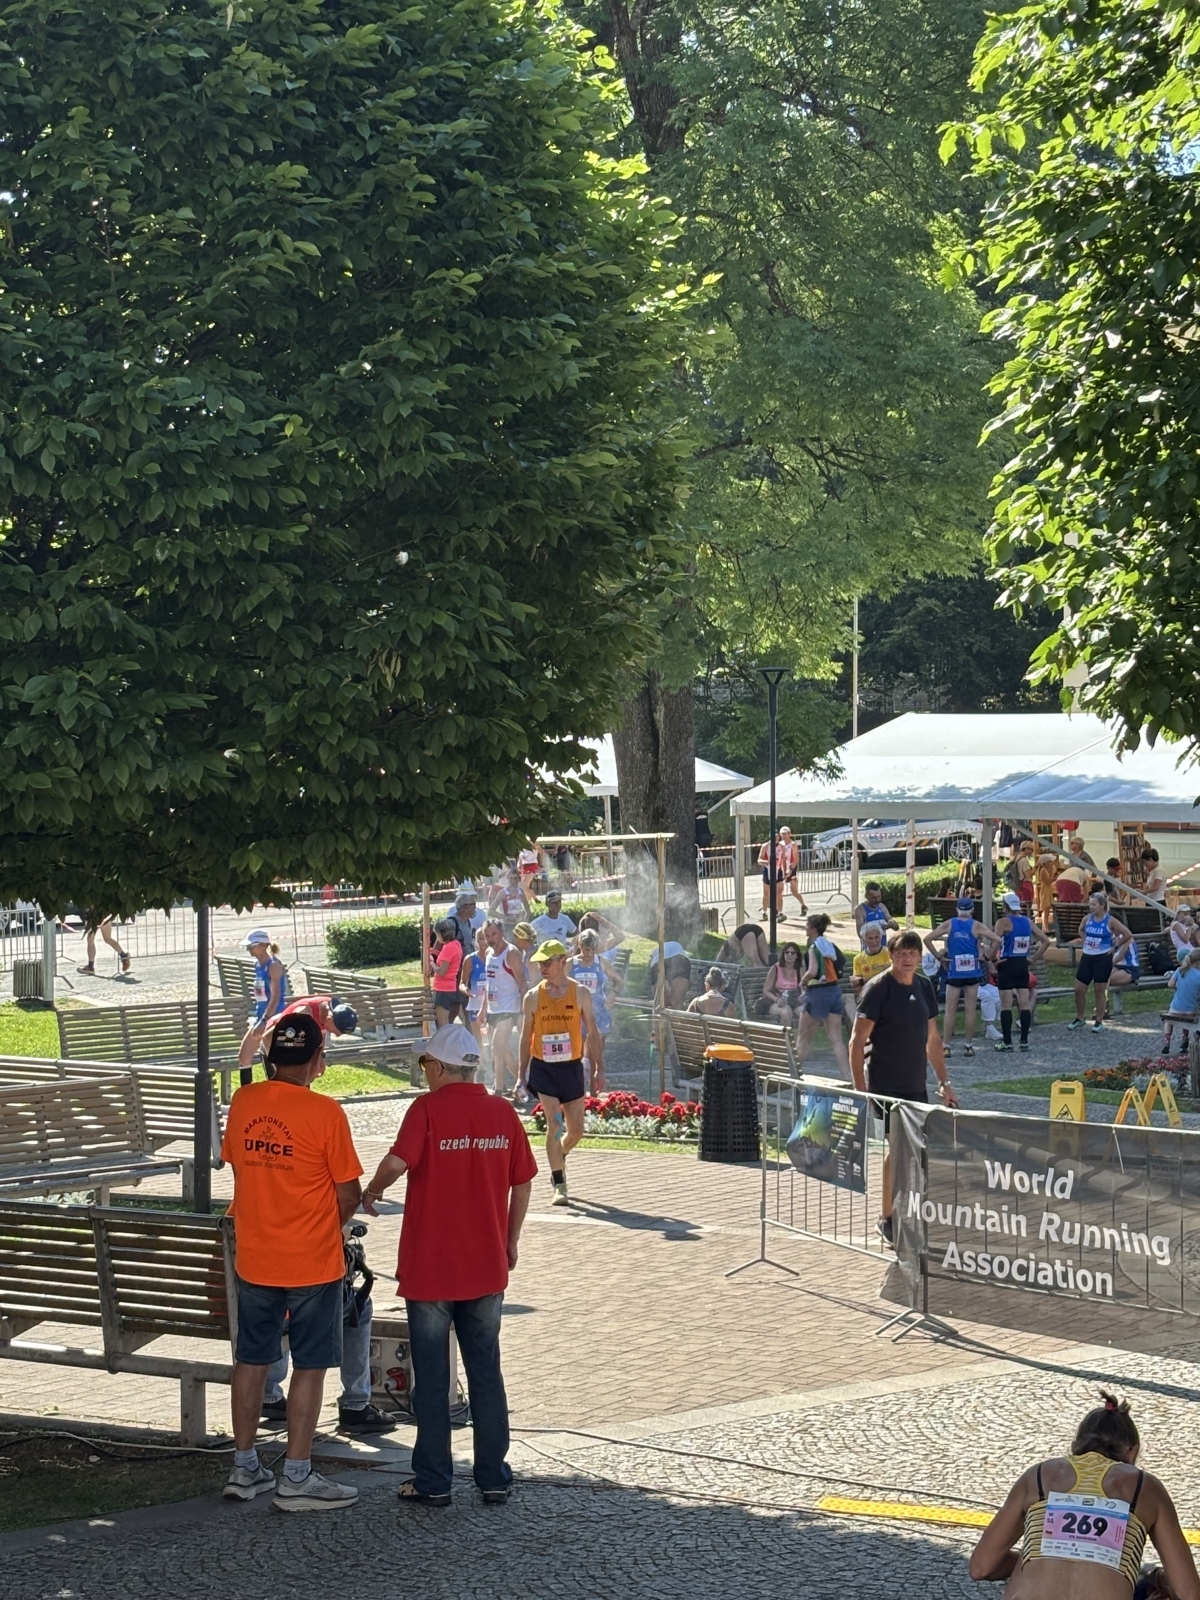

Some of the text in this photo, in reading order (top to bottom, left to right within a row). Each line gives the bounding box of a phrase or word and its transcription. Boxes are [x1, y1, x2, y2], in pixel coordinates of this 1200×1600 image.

[1085, 926, 1104, 935] ITALIA
[551, 1043, 564, 1053] 58
[439, 1134, 510, 1152] czech republic
[983, 1159, 1074, 1200] World
[907, 1190, 1171, 1267] Mountain Running
[941, 1241, 1113, 1297] Association
[1062, 1512, 1108, 1537] 269
